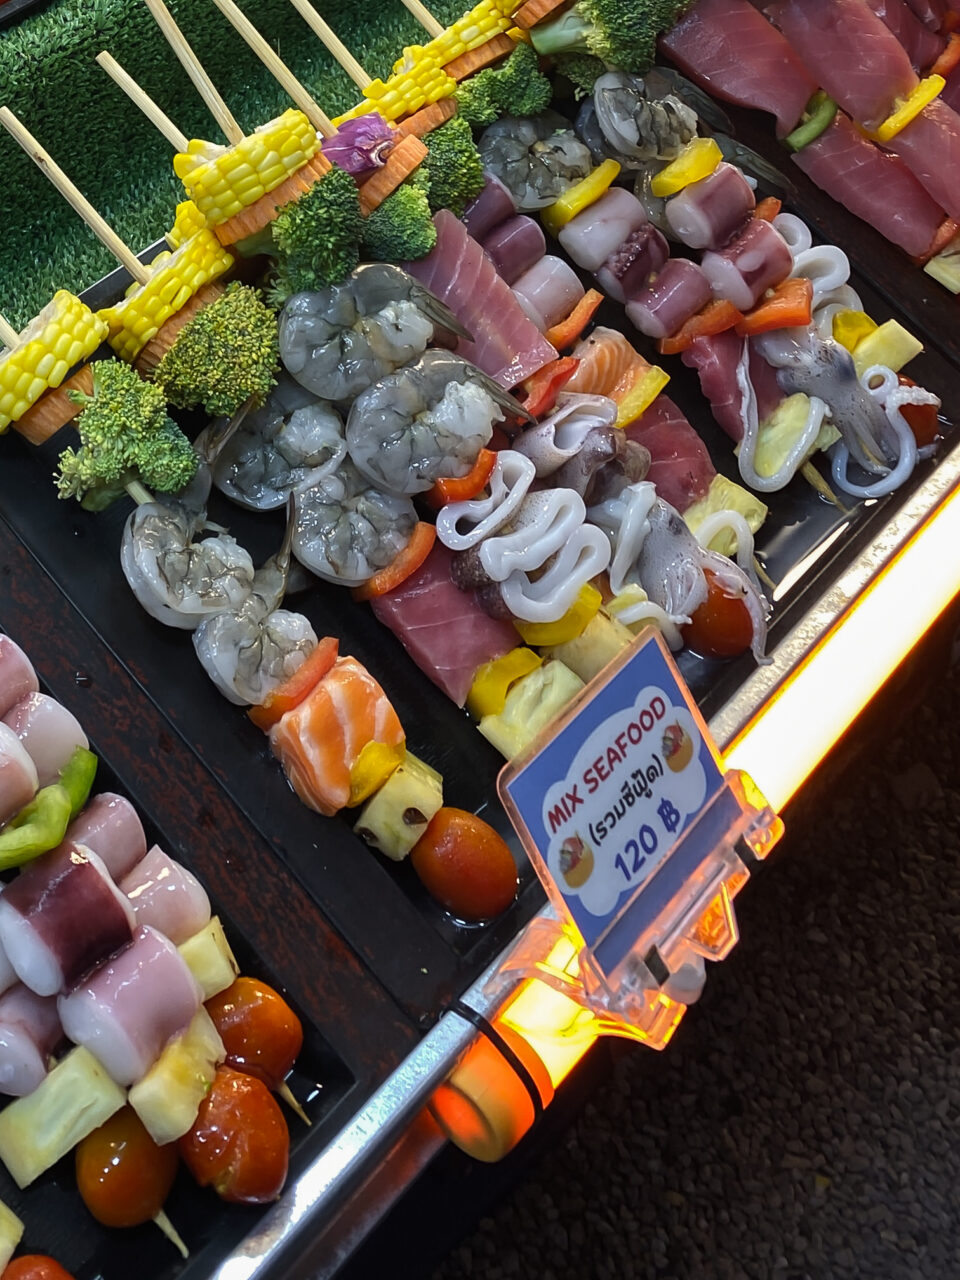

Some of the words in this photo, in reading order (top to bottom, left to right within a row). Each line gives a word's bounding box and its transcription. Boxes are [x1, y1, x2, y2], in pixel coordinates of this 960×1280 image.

[547, 783, 585, 834] MIX
[582, 695, 666, 795] SEAFOOD
[614, 824, 658, 882] 120
